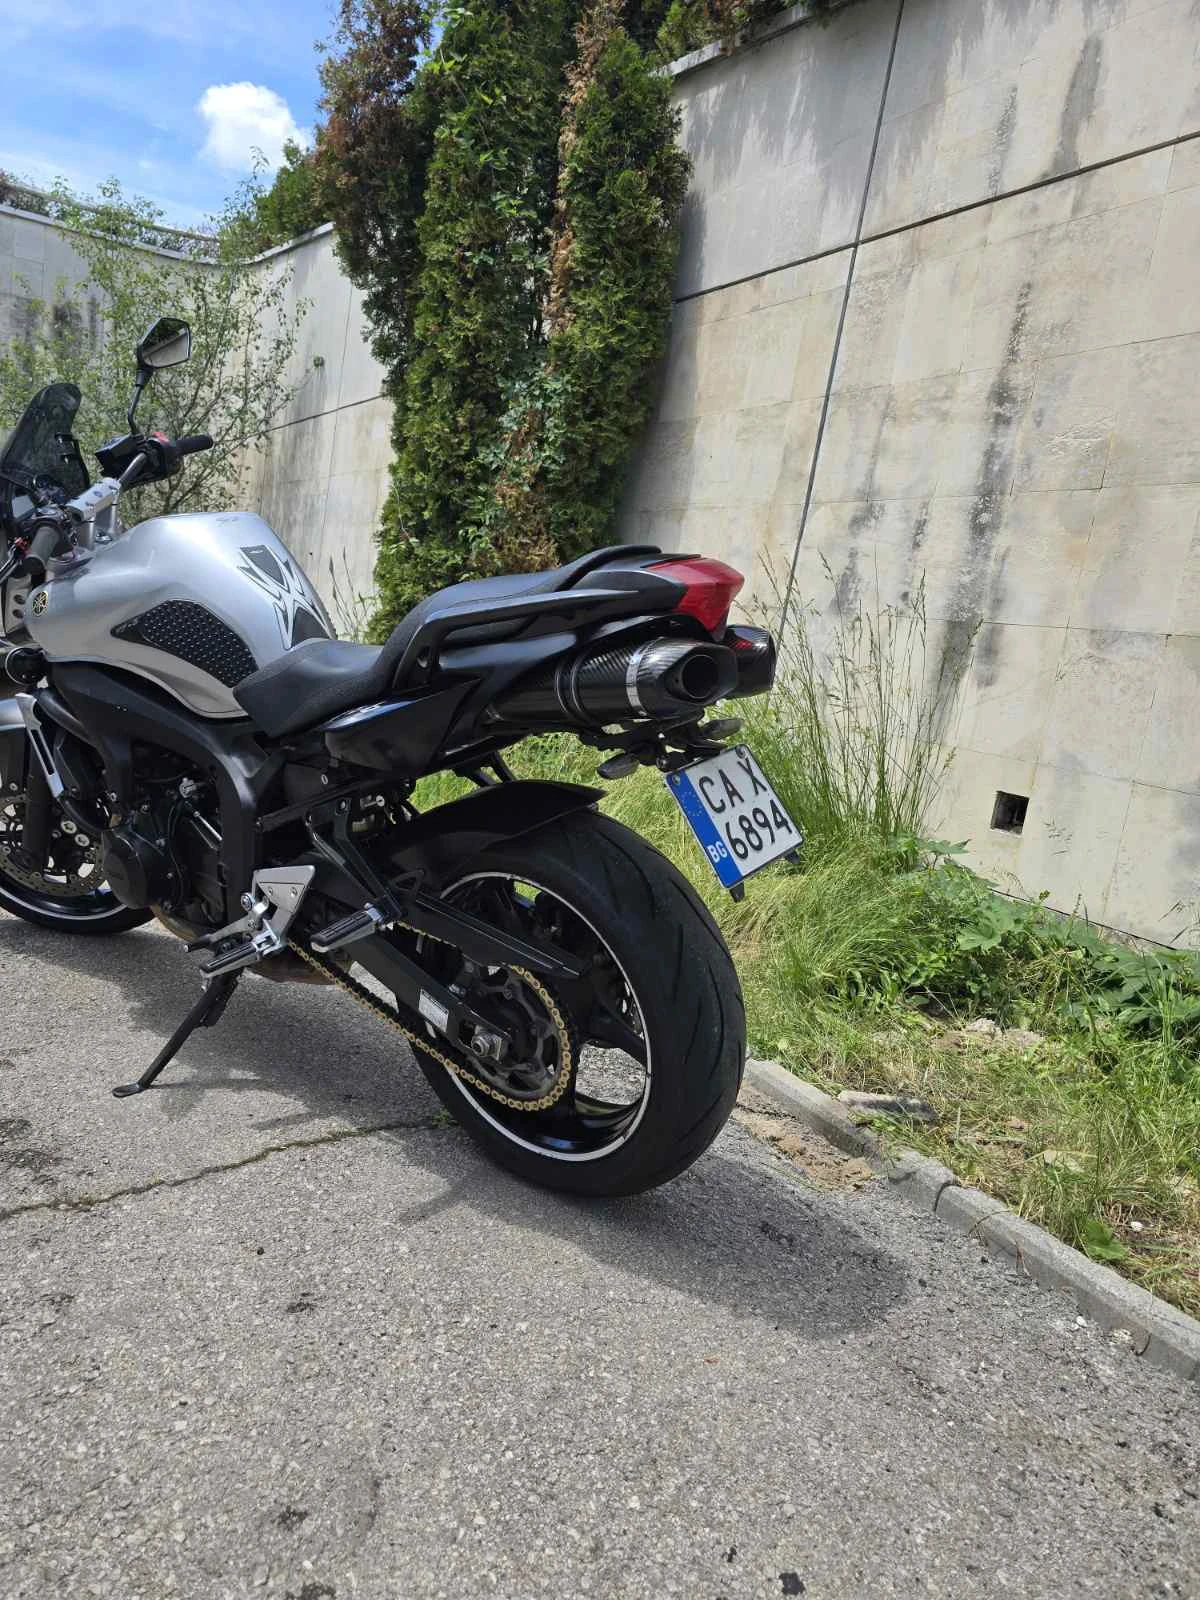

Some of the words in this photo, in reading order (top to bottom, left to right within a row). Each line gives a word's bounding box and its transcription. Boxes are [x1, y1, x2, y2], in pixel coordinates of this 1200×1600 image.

[698, 769, 744, 813] CA
[737, 757, 767, 796] X
[707, 841, 728, 863] BG
[725, 799, 793, 860] 6894
